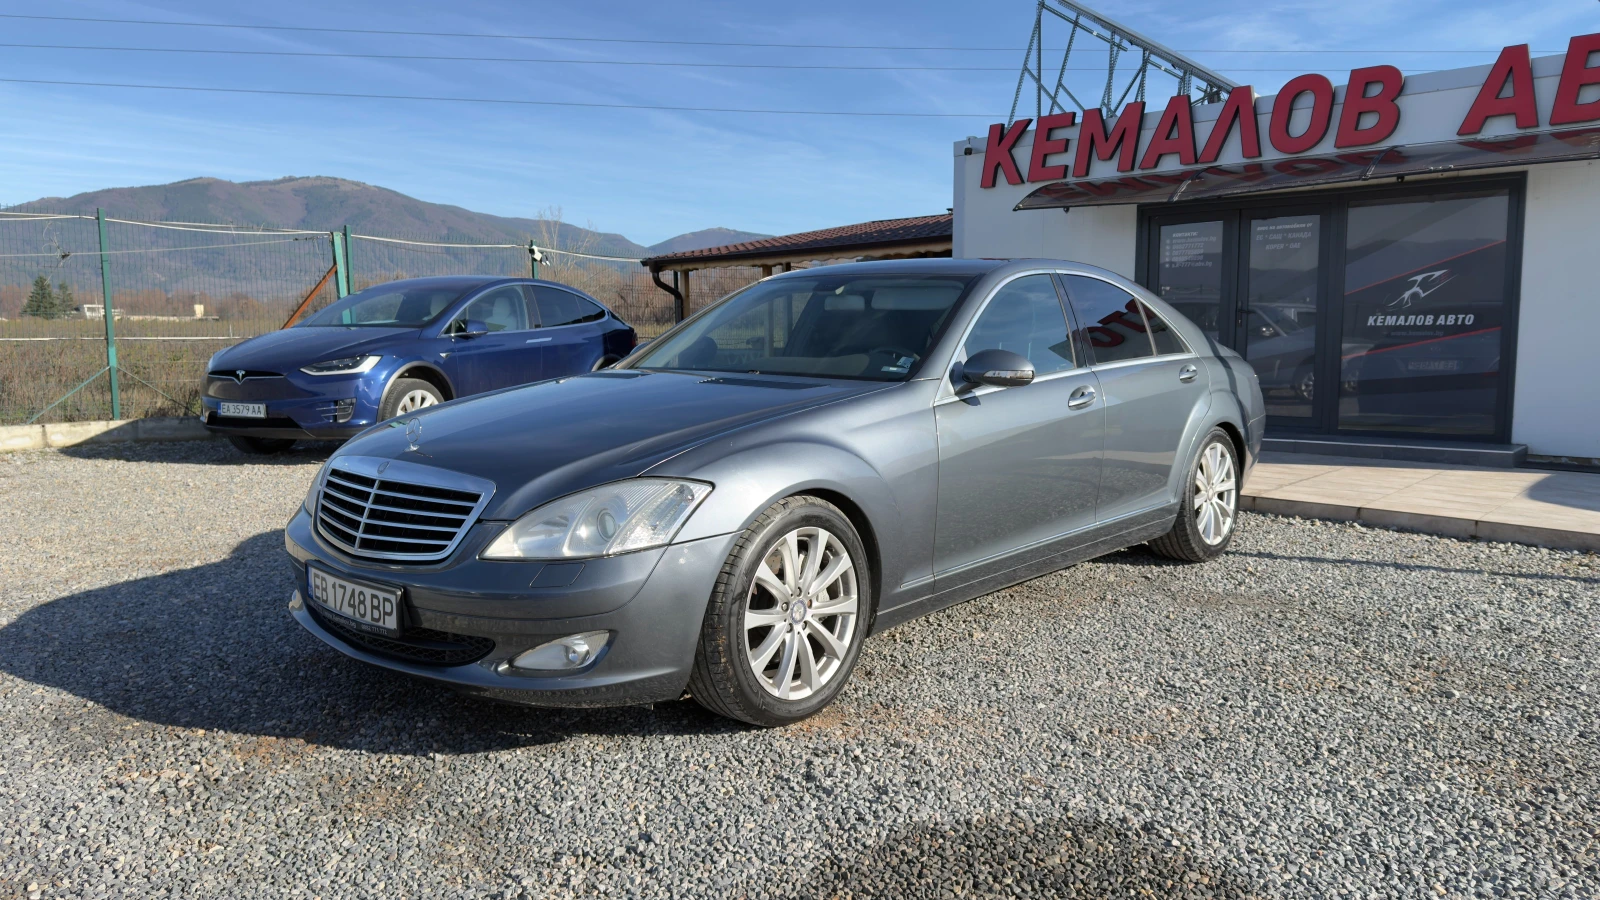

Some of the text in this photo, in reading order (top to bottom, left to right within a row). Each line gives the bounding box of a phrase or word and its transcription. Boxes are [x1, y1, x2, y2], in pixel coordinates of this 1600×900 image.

[979, 65, 1405, 188] КЕМАЛОВ
[1287, 231, 1312, 239] КАНАДА
[1367, 313, 1475, 326] КЕМАЛОВ АВТО
[221, 403, 231, 414] EA
[232, 404, 250, 415] 3579
[251, 405, 262, 415] AA
[313, 572, 328, 604] EB
[331, 581, 367, 619] 1748
[370, 593, 394, 625] BP
